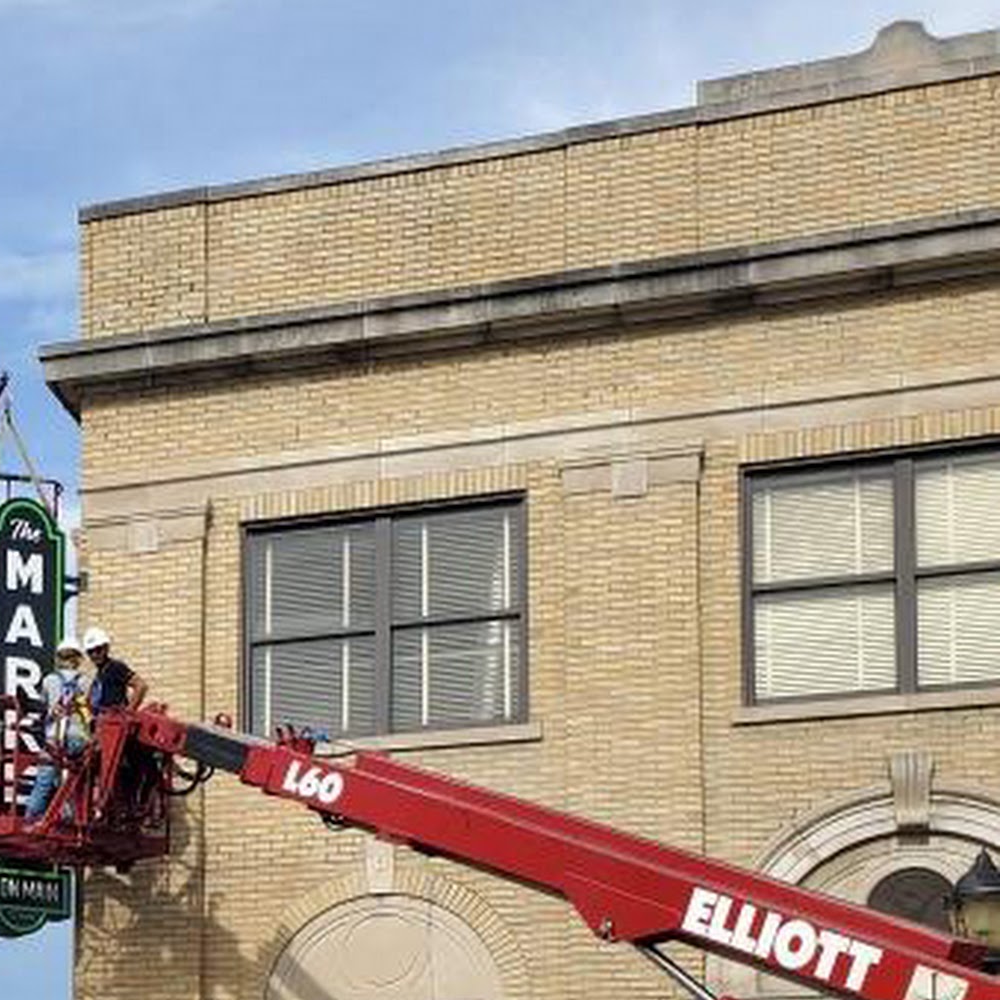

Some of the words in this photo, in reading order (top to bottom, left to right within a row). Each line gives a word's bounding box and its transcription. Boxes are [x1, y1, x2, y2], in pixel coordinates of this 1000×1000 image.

[10, 518, 43, 543] The
[3, 550, 44, 804] MARKE
[282, 760, 344, 804] L60
[681, 887, 883, 993] ELLIOTT
